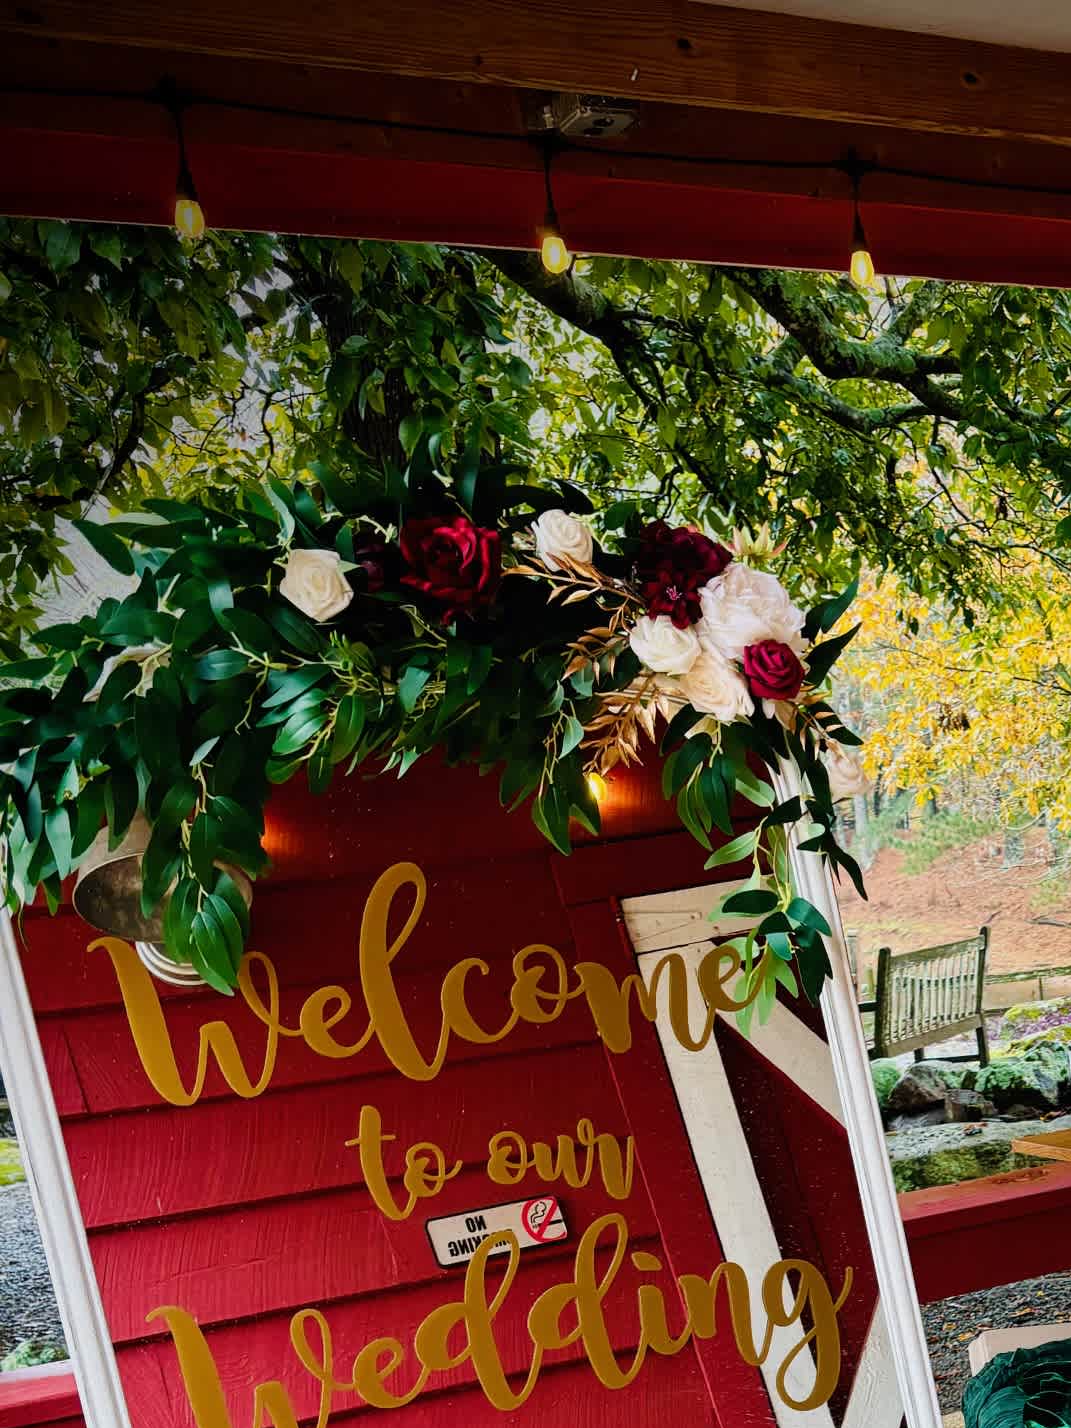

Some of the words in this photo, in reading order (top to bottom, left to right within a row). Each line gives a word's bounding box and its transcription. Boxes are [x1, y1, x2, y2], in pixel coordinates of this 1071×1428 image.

[88, 861, 768, 1107] Welcome
[346, 1104, 462, 1222] to
[487, 1118, 635, 1201] our
